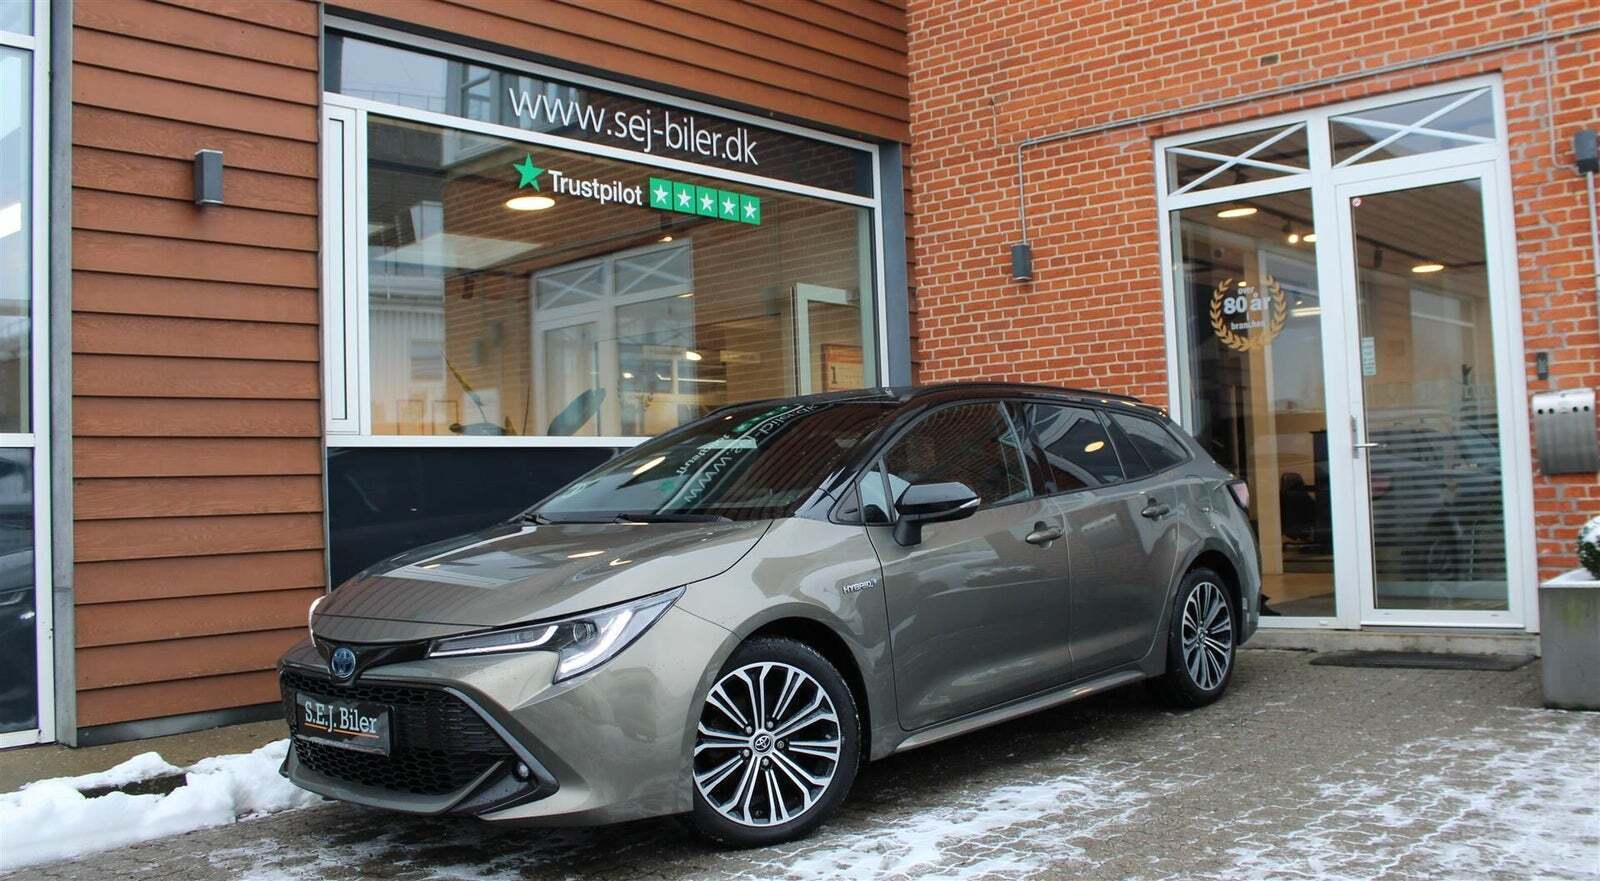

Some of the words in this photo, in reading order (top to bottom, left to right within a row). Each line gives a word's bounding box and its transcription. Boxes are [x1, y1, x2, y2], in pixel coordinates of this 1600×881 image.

[508, 87, 759, 166] www.sej-biler.dk
[547, 169, 644, 207] Trustpilot
[1223, 295, 1248, 315] 80
[1237, 286, 1255, 296] over
[305, 701, 337, 732] S.E.J.
[340, 707, 377, 733] Biler
